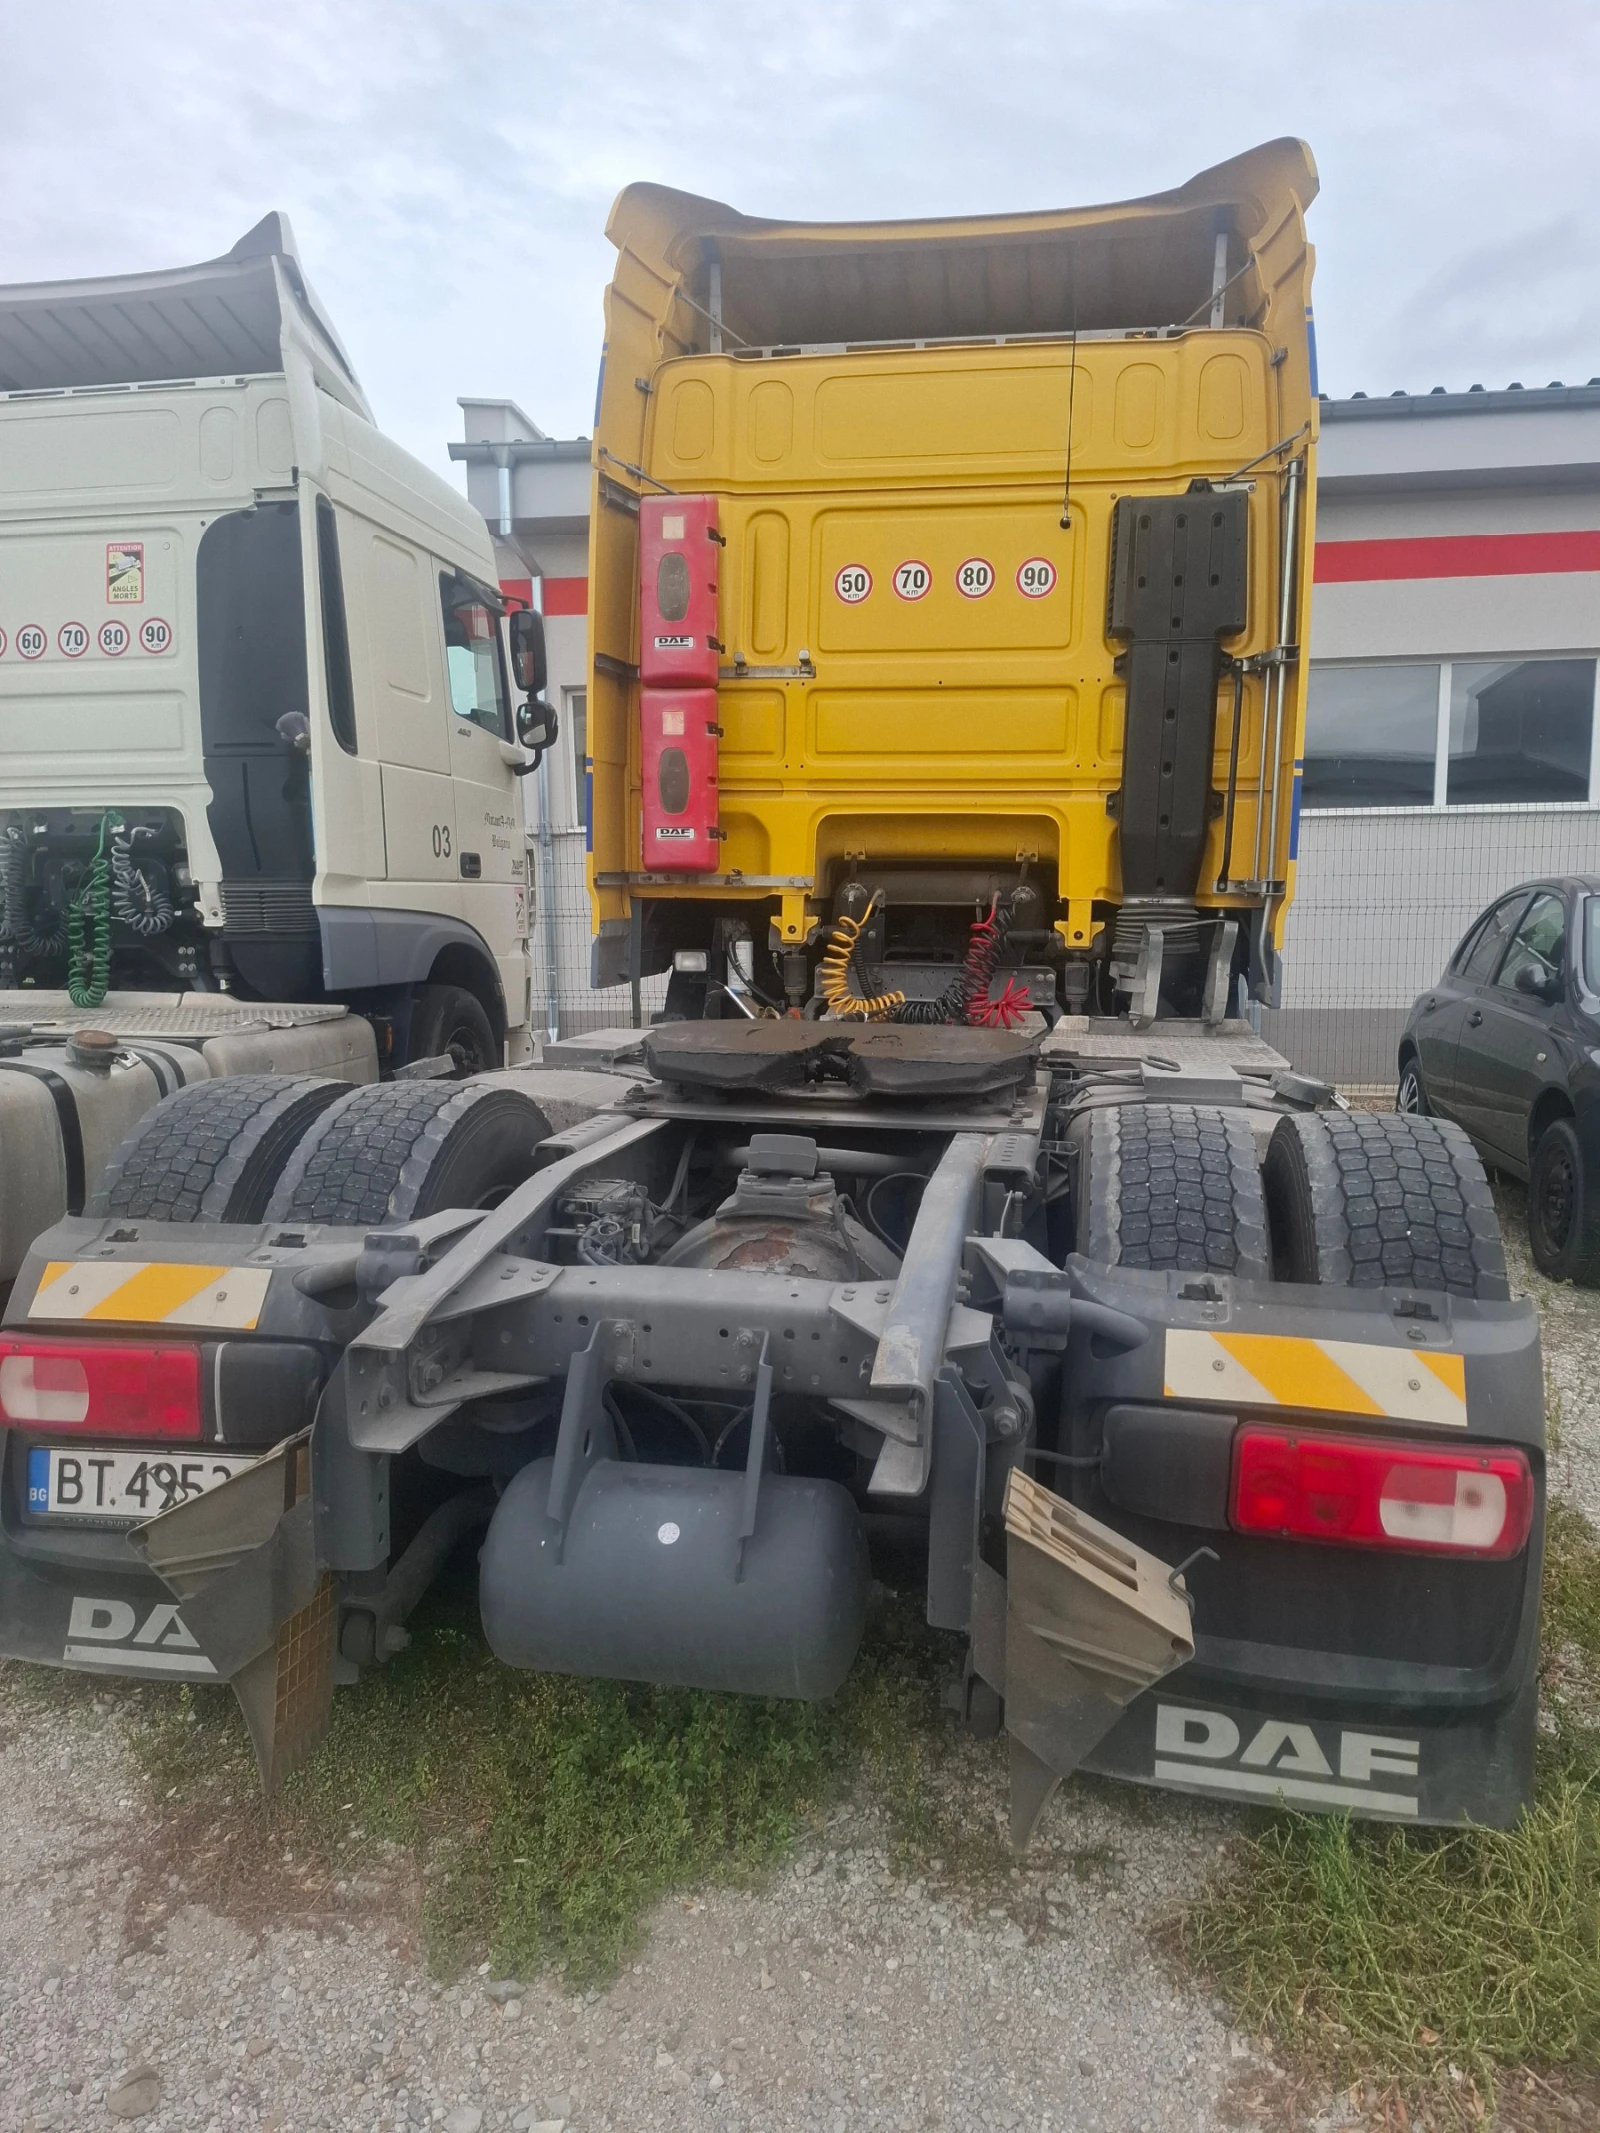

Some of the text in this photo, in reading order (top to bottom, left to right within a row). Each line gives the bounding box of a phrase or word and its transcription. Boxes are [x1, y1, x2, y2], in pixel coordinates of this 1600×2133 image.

[842, 573, 866, 593] 50
[900, 569, 925, 589] 70
[963, 567, 988, 586] 80
[1024, 567, 1050, 587] 90
[113, 592, 138, 600] MORTS
[22, 632, 42, 649] 60
[63, 629, 84, 647] 70
[103, 629, 123, 646] 80
[145, 625, 166, 643] 90
[432, 824, 452, 859] 03
[57, 1458, 115, 1506] BT
[29, 1487, 47, 1502] BG
[67, 1596, 201, 1648] DA
[1155, 1703, 1421, 1782] DAF
